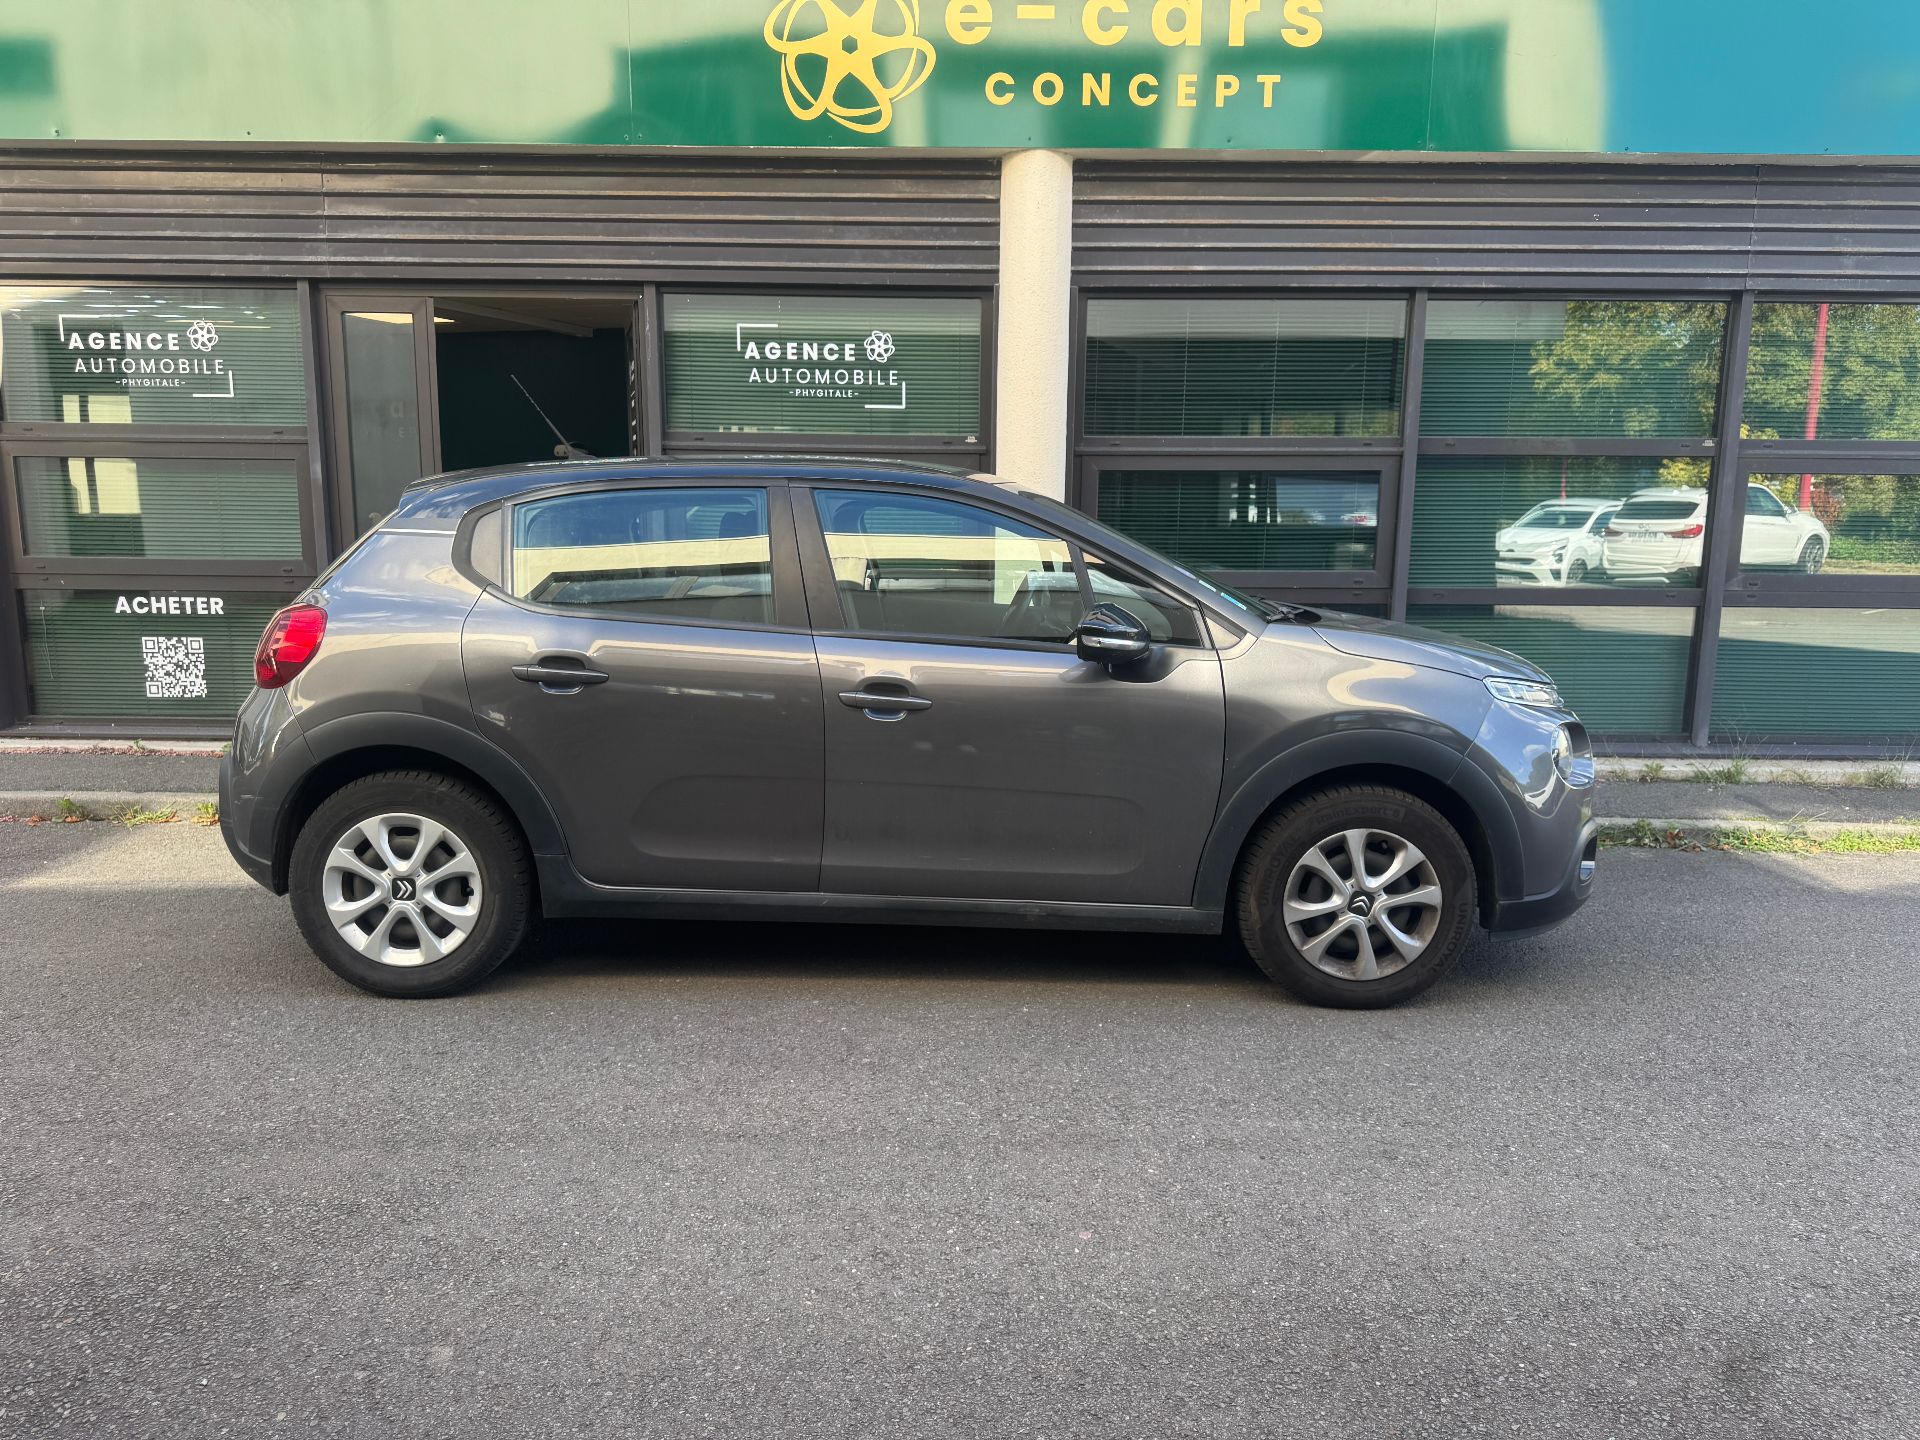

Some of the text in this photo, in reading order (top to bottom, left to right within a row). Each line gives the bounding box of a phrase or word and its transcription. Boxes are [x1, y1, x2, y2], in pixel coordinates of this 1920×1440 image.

[945, 0, 1323, 47] e-cars
[985, 72, 1281, 108] CONCEPT
[68, 331, 180, 351] AGENCE
[744, 341, 857, 362] AGENCE
[74, 357, 225, 375] AUTOMOBILE
[748, 367, 899, 386] AUTOMOBILE
[115, 595, 225, 615] ACHETER
[1427, 902, 1469, 975] UNIROYAL
